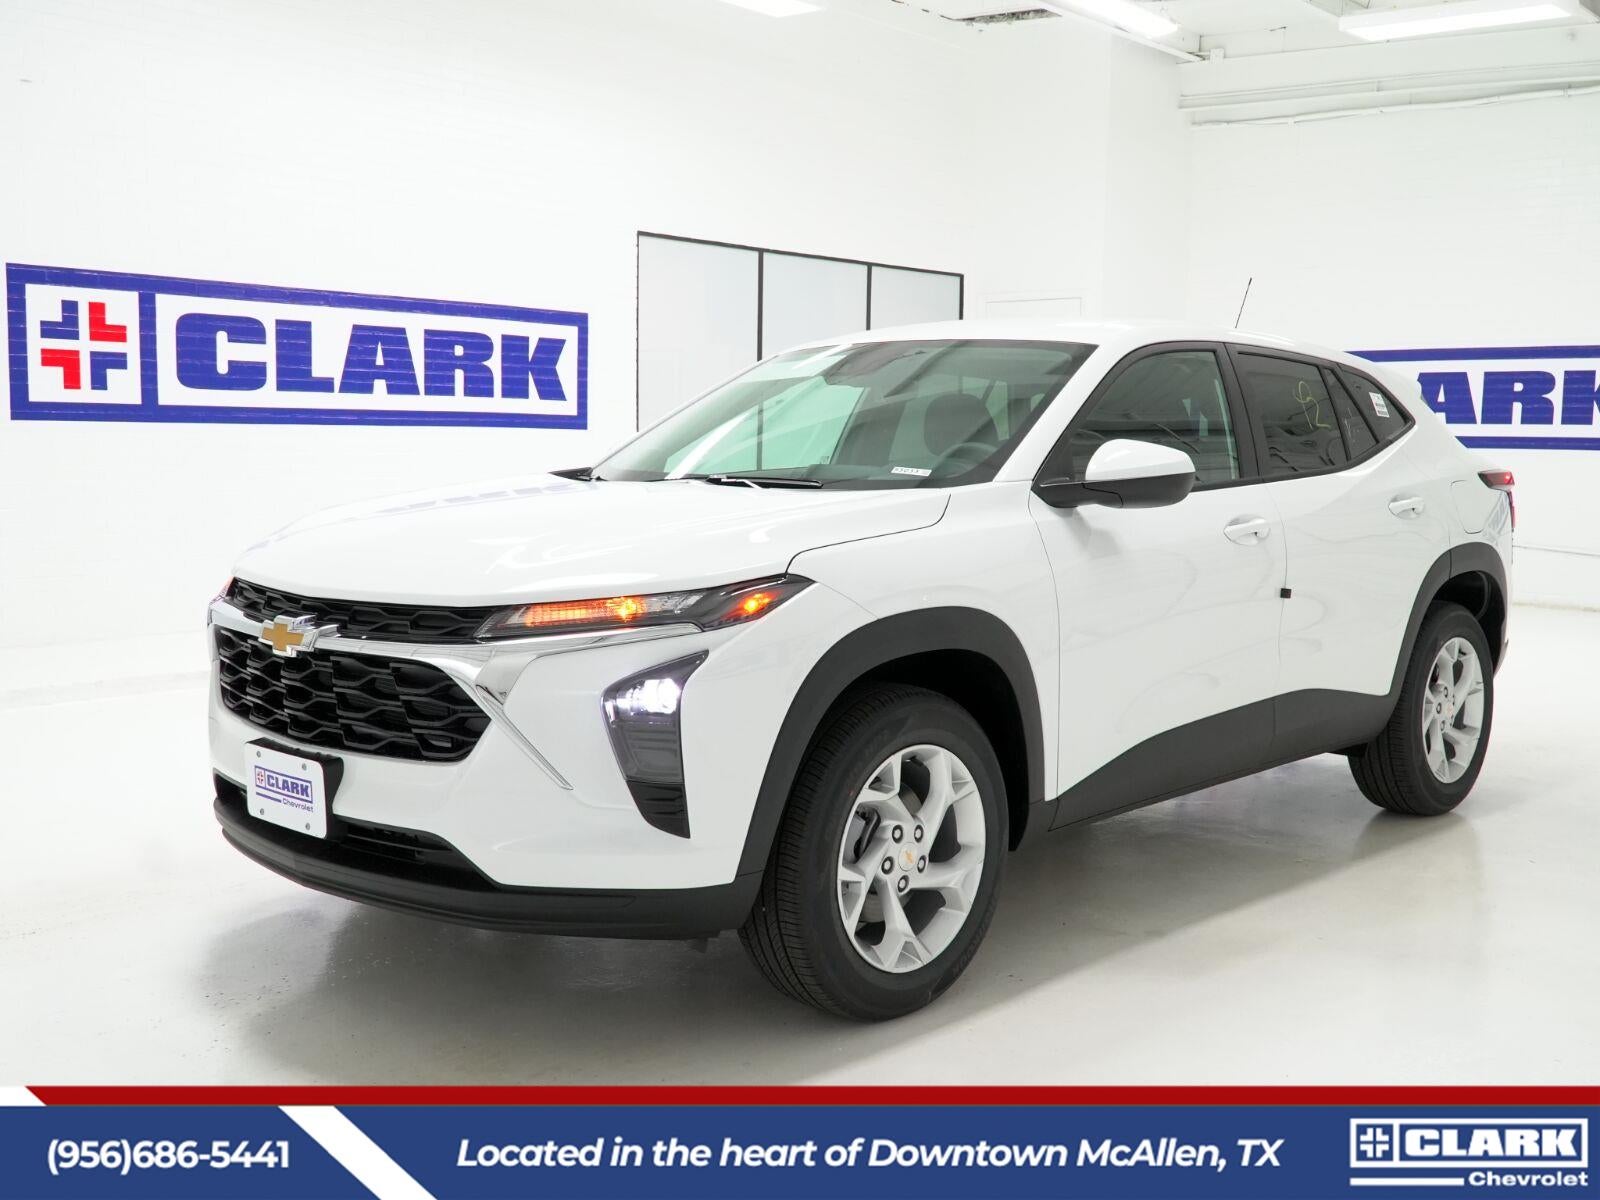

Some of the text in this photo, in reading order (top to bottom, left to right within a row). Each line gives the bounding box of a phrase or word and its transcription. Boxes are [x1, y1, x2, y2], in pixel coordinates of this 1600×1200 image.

[175, 312, 567, 401] CLARK
[266, 774, 310, 798] CLARK
[282, 798, 314, 813] Chevrolet
